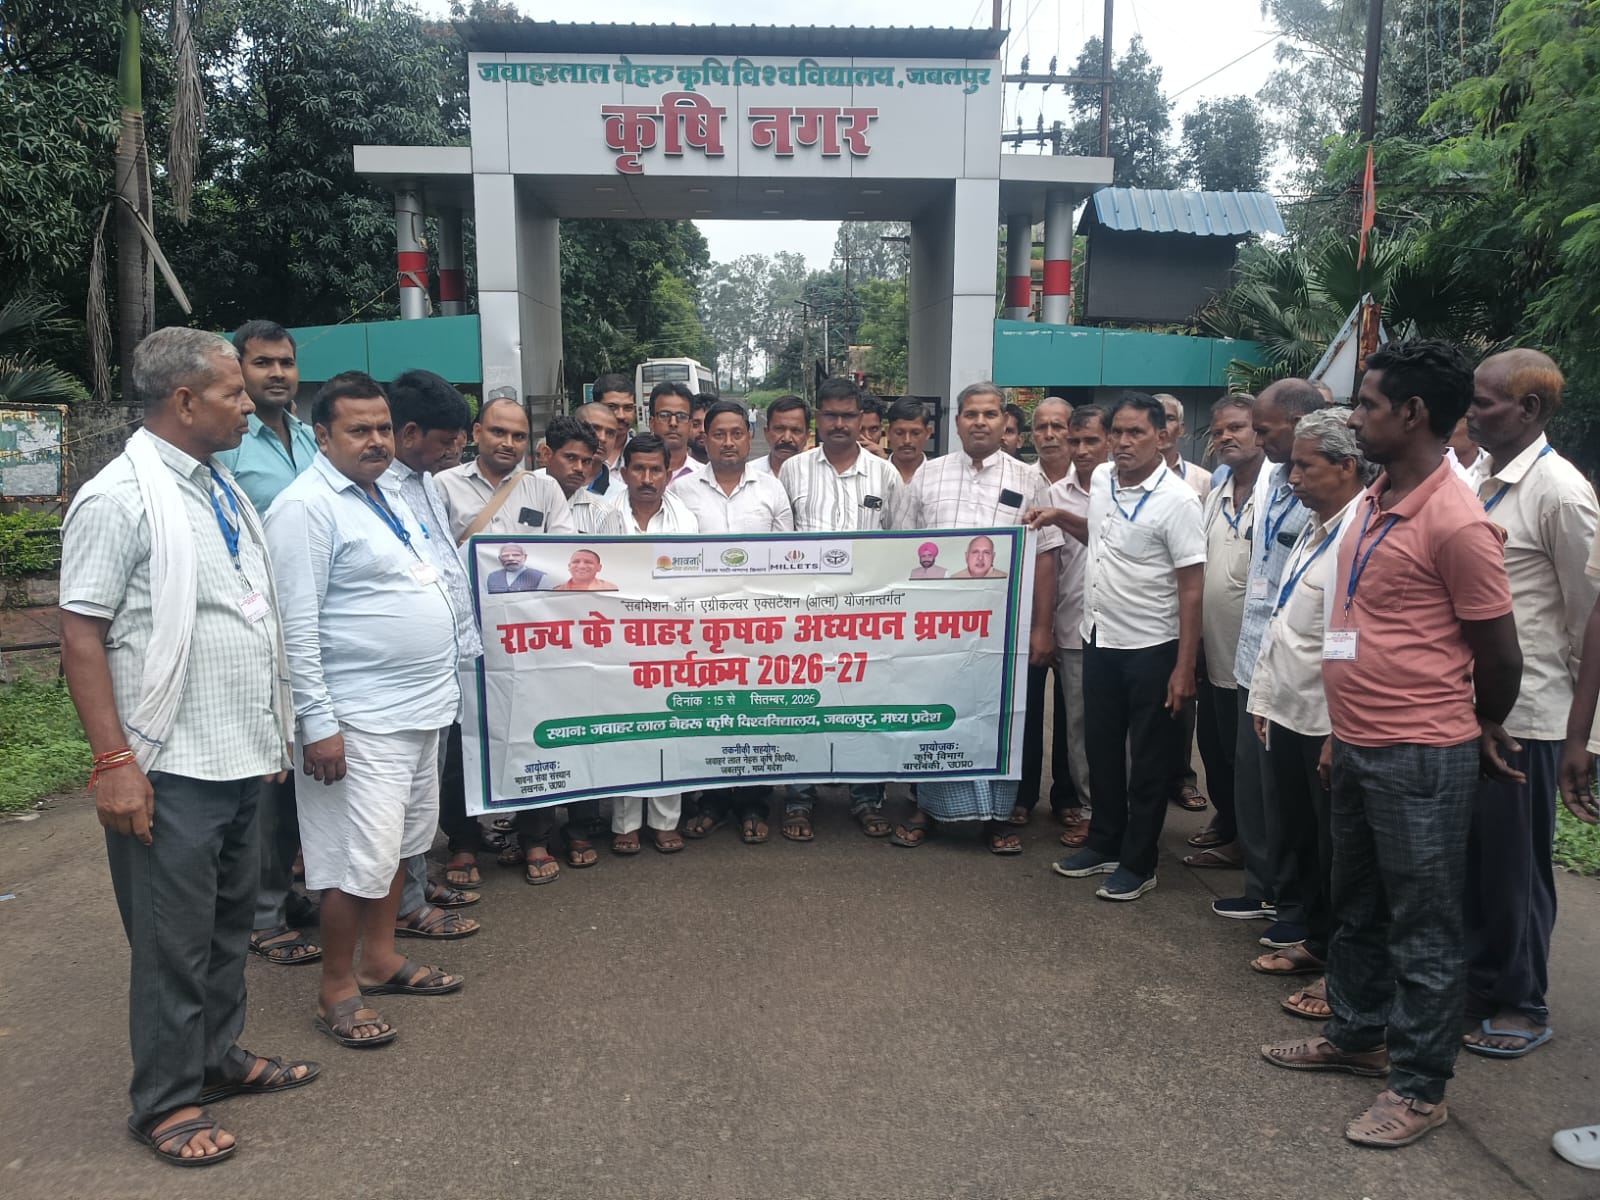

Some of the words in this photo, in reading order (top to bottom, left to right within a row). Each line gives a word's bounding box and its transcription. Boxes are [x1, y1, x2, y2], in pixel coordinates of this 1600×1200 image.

[477, 62, 610, 86] जवाहरलाल
[677, 57, 730, 91] कृषि
[906, 67, 991, 95] जबलपुर
[601, 91, 726, 174] कृषि
[749, 106, 879, 156] नगर
[770, 563, 818, 571] MILLETS
[674, 597, 694, 613] ऑन
[700, 597, 749, 612] एग्रीकल्चर
[805, 594, 839, 611] (आत्मा)
[497, 620, 575, 654] राज्य
[579, 611, 615, 648] के
[620, 618, 694, 646] बाहर
[700, 616, 786, 653] कृषक
[794, 612, 907, 644] अध्ययन
[914, 610, 993, 642] भ्रमण
[629, 651, 749, 689] कार्यक्रम
[758, 652, 868, 685] 2026-27
[672, 693, 703, 707] दिनांक
[726, 692, 736, 705] से
[750, 692, 788, 706] सितम्बर,
[791, 694, 815, 705] 2026
[590, 721, 633, 735] जवाहर
[636, 719, 666, 732] लाल
[706, 714, 734, 732] कृषि
[737, 713, 820, 728] विश्वविद्यालय,
[823, 713, 877, 728] जबलपुर,
[881, 712, 908, 724] मध्य
[911, 710, 941, 724] प्रदेश
